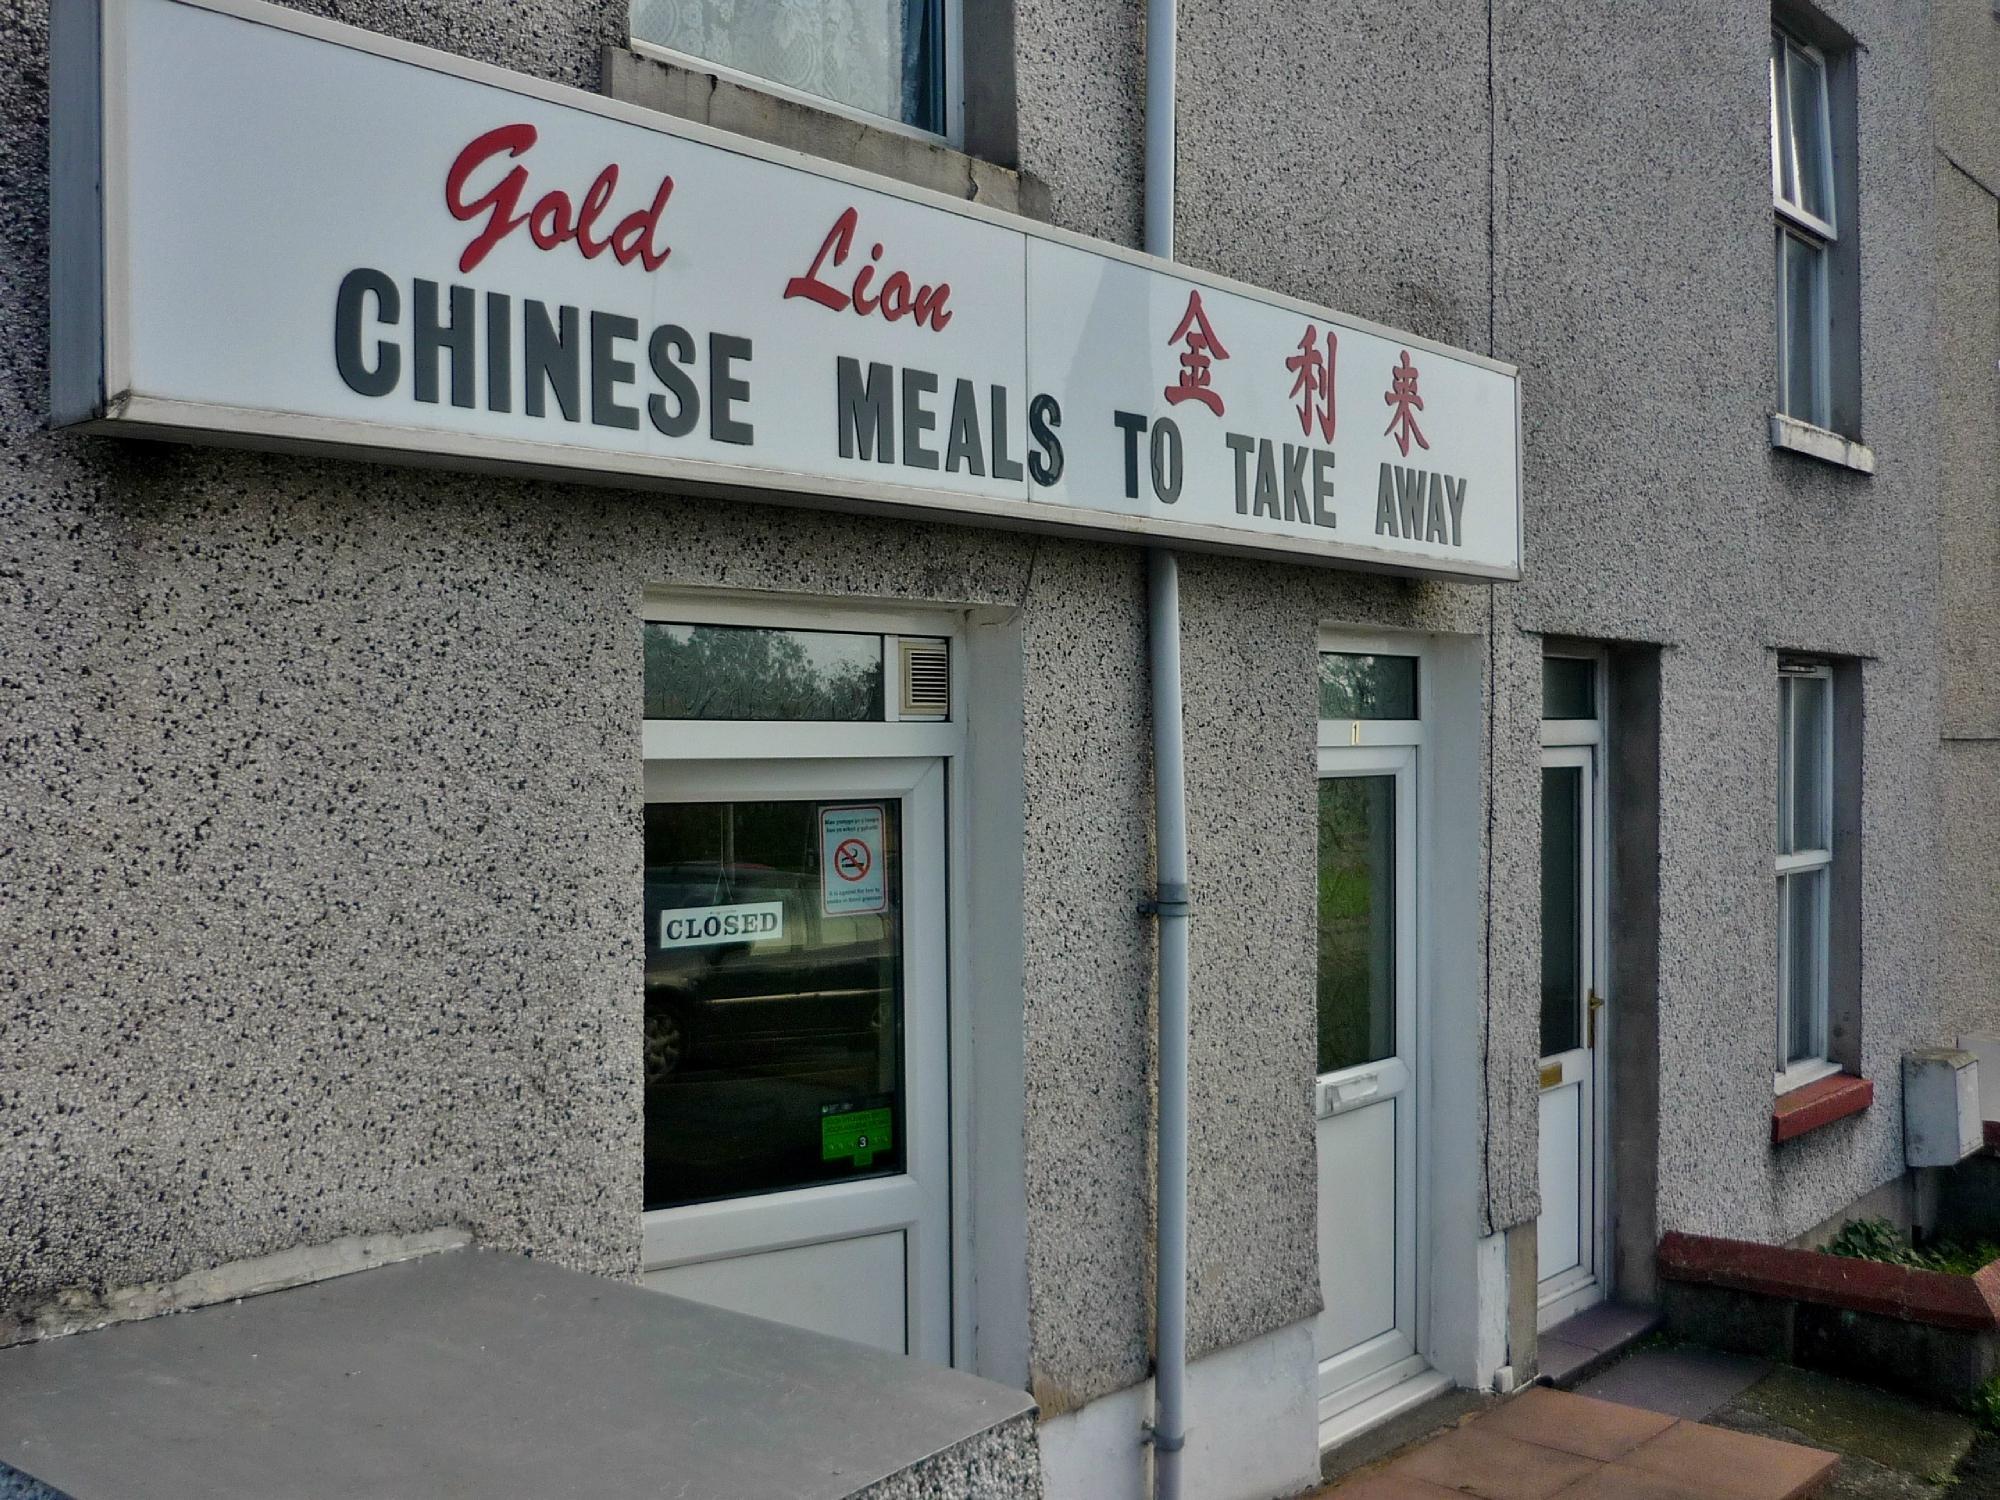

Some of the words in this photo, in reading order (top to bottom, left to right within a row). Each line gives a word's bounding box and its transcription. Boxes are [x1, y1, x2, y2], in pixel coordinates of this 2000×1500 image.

[445, 122, 673, 273] Gold
[784, 206, 953, 333] Lion
[334, 266, 755, 447] CHINESE
[836, 354, 1065, 488] MEALS
[1113, 409, 1184, 505] TO
[1225, 431, 1337, 529] TAKE
[1374, 462, 1468, 547] AWAY
[666, 912, 778, 940] CLOSED
[859, 1136, 867, 1148] 3
